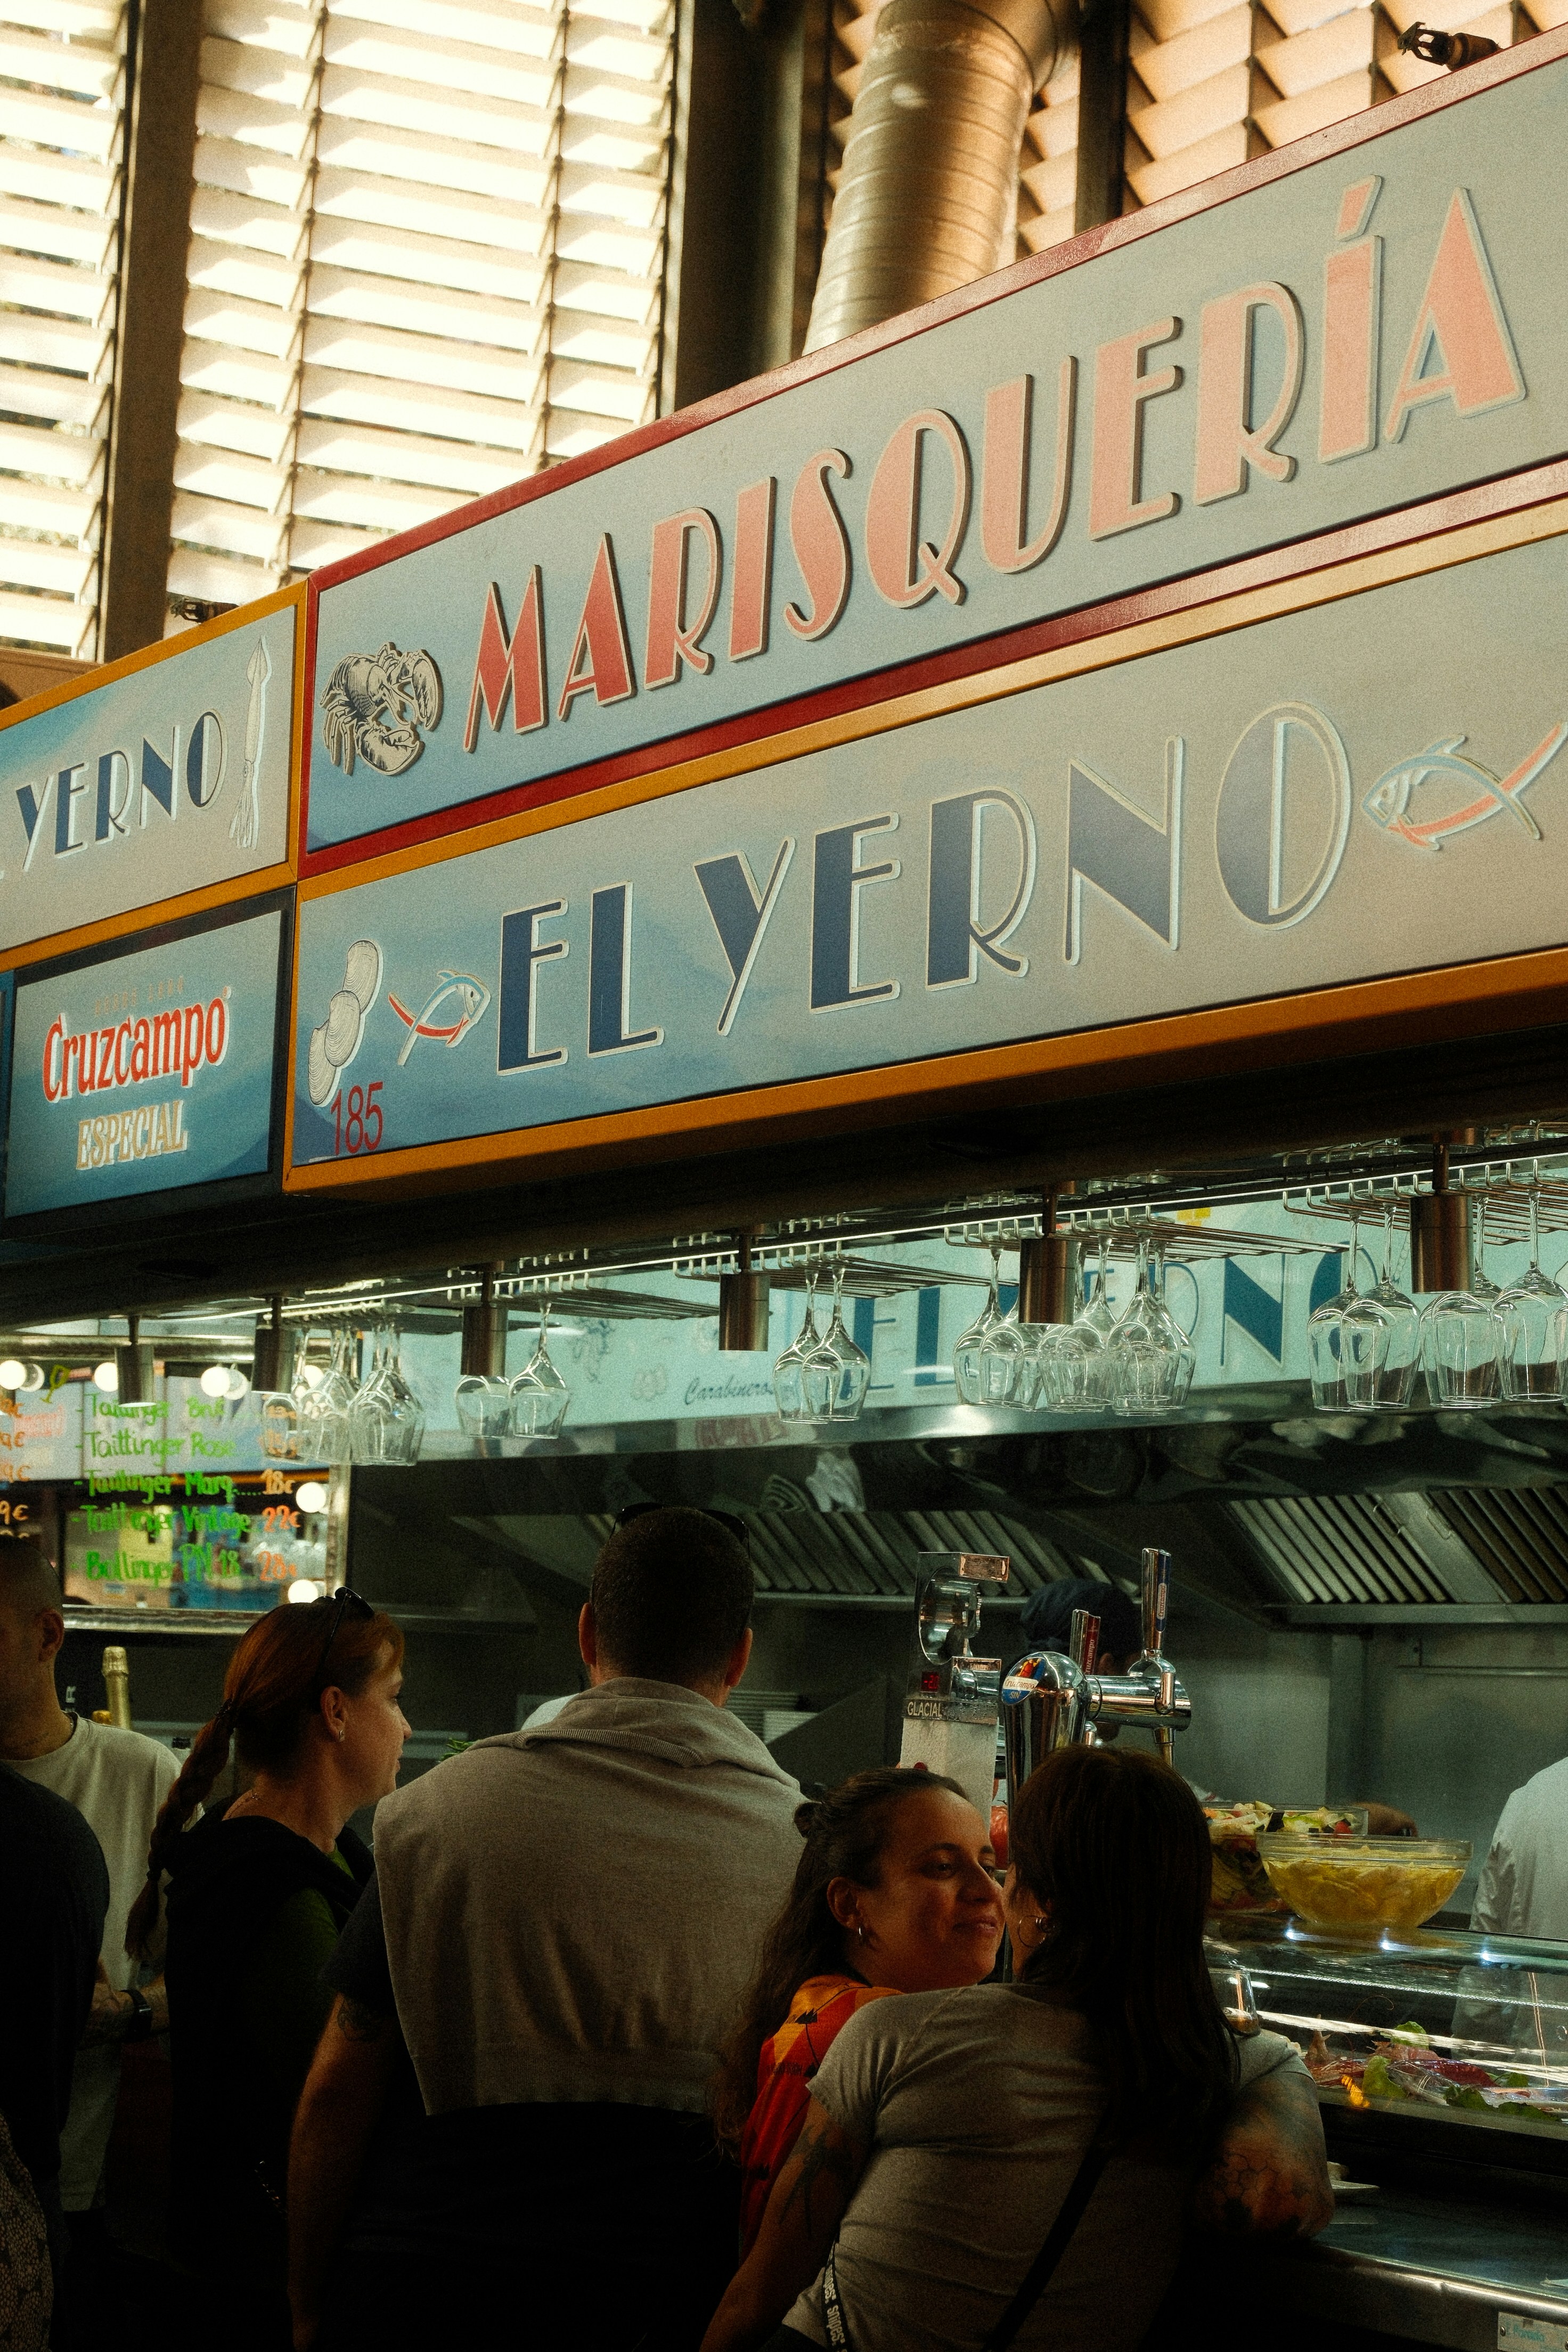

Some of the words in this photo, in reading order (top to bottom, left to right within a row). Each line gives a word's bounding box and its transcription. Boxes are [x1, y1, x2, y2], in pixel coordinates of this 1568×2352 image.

[463, 174, 1524, 754] MARISQUERÍA
[15, 708, 227, 872] YERNO
[496, 881, 665, 1075] EL
[692, 700, 1351, 1036] YERNO
[43, 998, 230, 1103] Cruzcampo
[76, 1100, 188, 1170] ESPECIAL
[331, 1081, 383, 1156] 185
[84, 1428, 185, 1466] Taittinger
[1005, 1678, 1035, 1689] Cruzcampo
[1085, 1639, 1095, 1673] ruzcampo
[907, 1701, 943, 1717] GLACIAL
